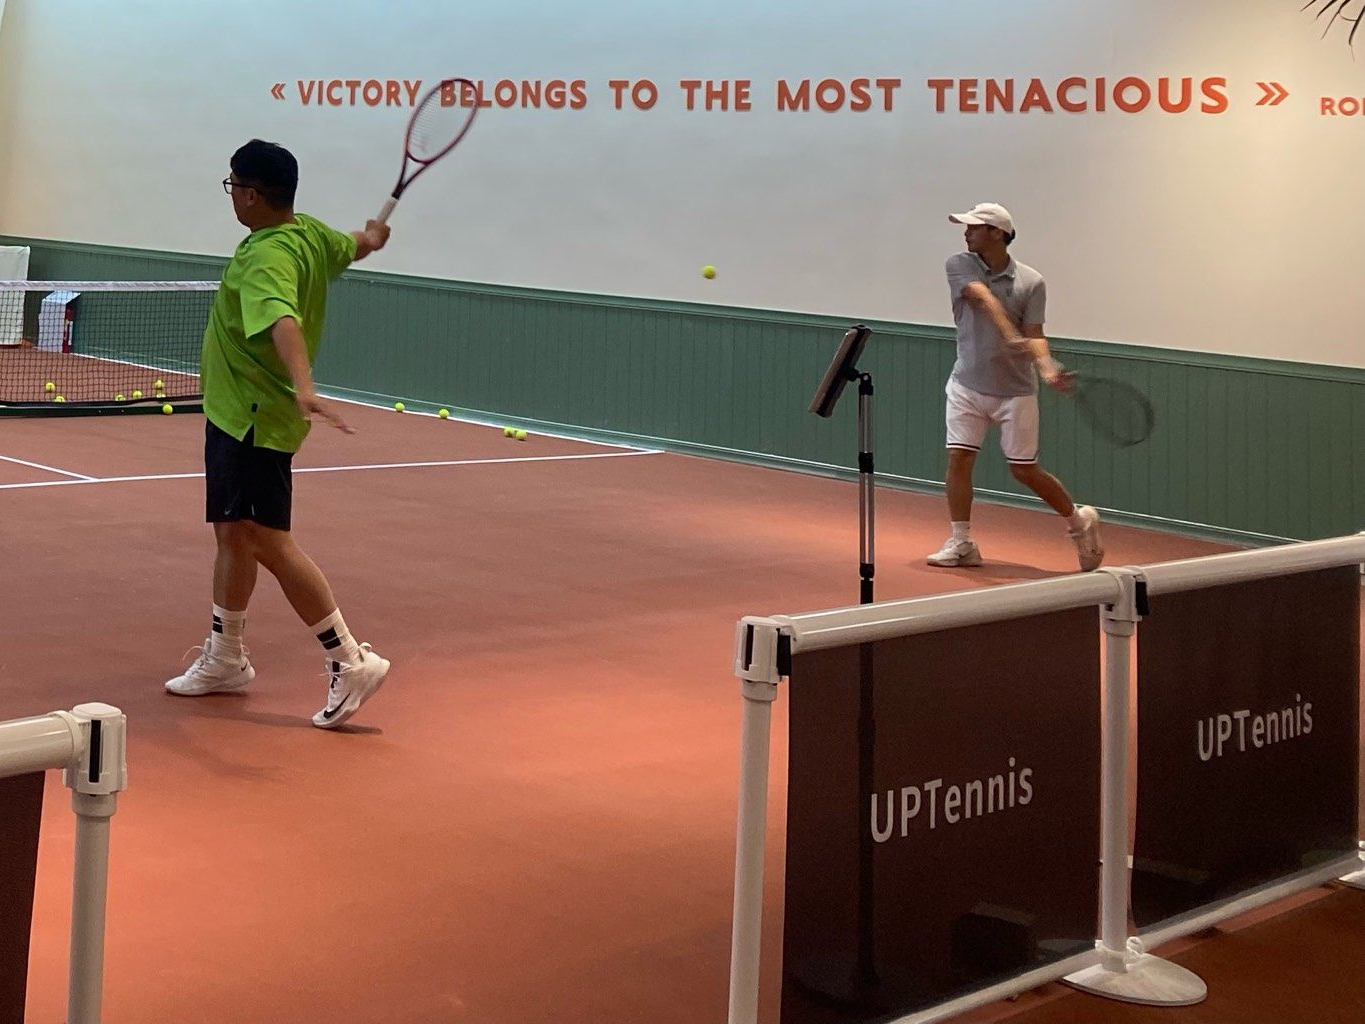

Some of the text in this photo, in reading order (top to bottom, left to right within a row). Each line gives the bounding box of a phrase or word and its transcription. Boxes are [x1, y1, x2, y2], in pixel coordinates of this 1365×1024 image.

[297, 79, 422, 107] VICTORY
[440, 79, 588, 109] BELONGS
[610, 79, 657, 110] TO
[679, 80, 750, 111] THE
[776, 79, 901, 111] MOST
[927, 77, 1229, 115] TENACIOUS
[1198, 693, 1314, 761] UPTennis
[869, 757, 1034, 844] UPTennis
